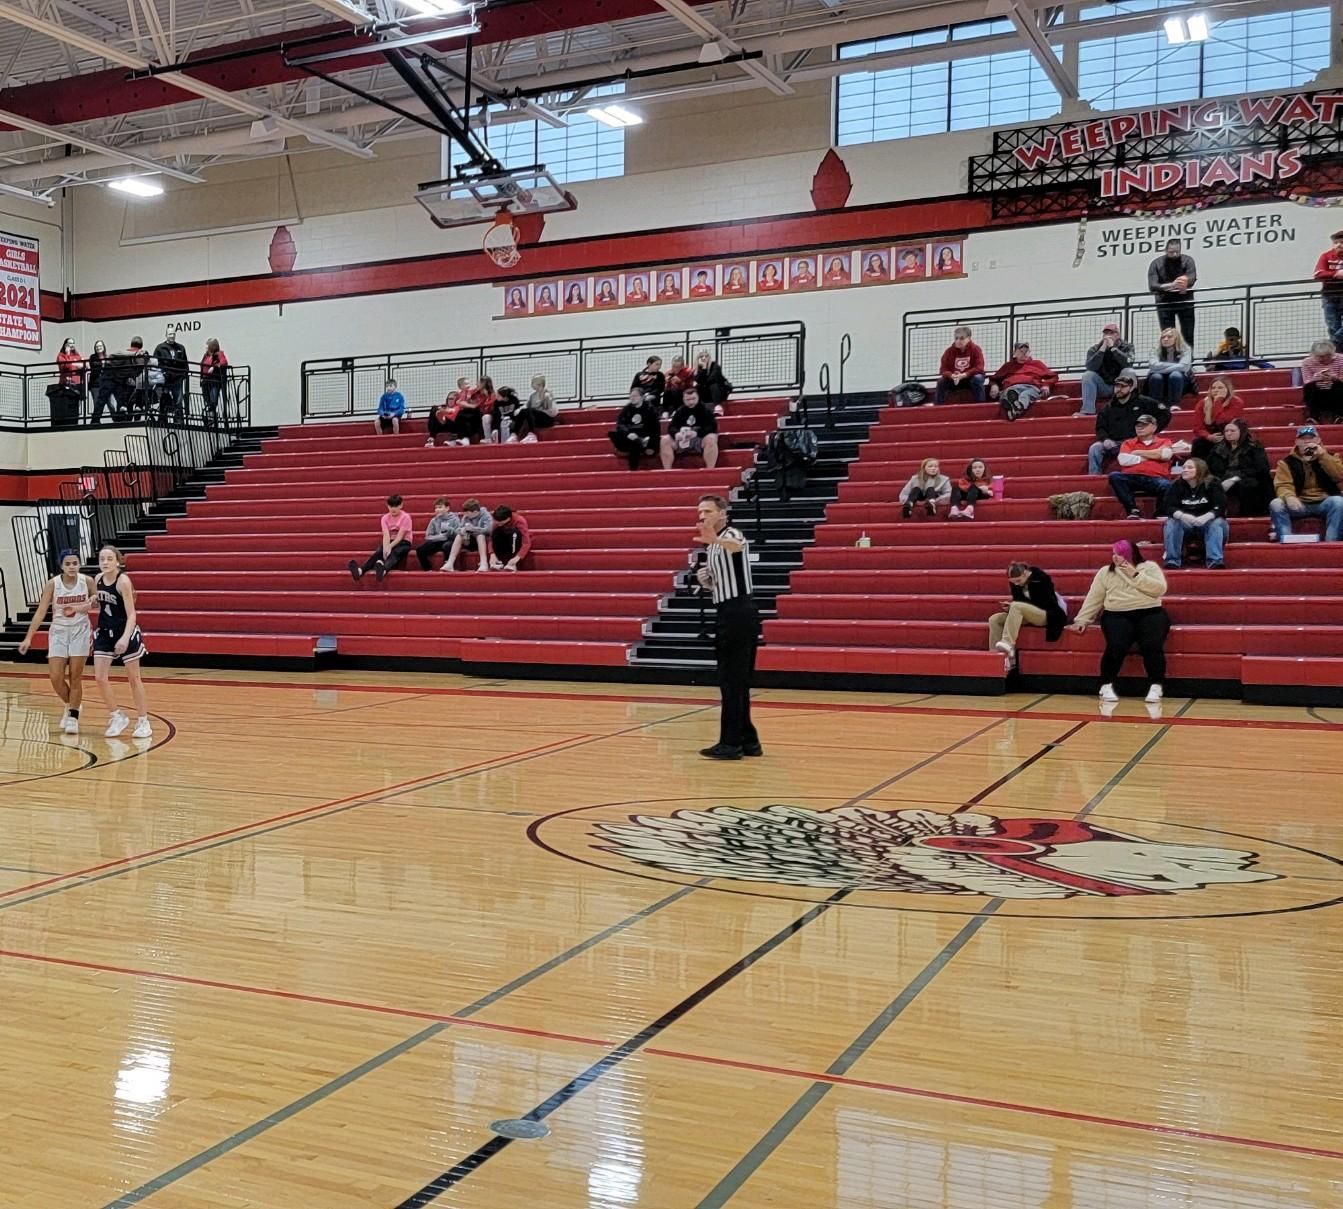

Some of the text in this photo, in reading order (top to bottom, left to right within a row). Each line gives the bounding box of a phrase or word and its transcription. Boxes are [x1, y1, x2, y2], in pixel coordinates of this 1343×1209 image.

[1012, 100, 1224, 170] WEEPING
[1100, 147, 1302, 198] INDIANS
[1097, 228, 1296, 258] STUDET SECTION
[1102, 214, 1283, 243] WEEPING WATER
[6, 249, 26, 261] GIRLS
[19, 240, 35, 249] WATER
